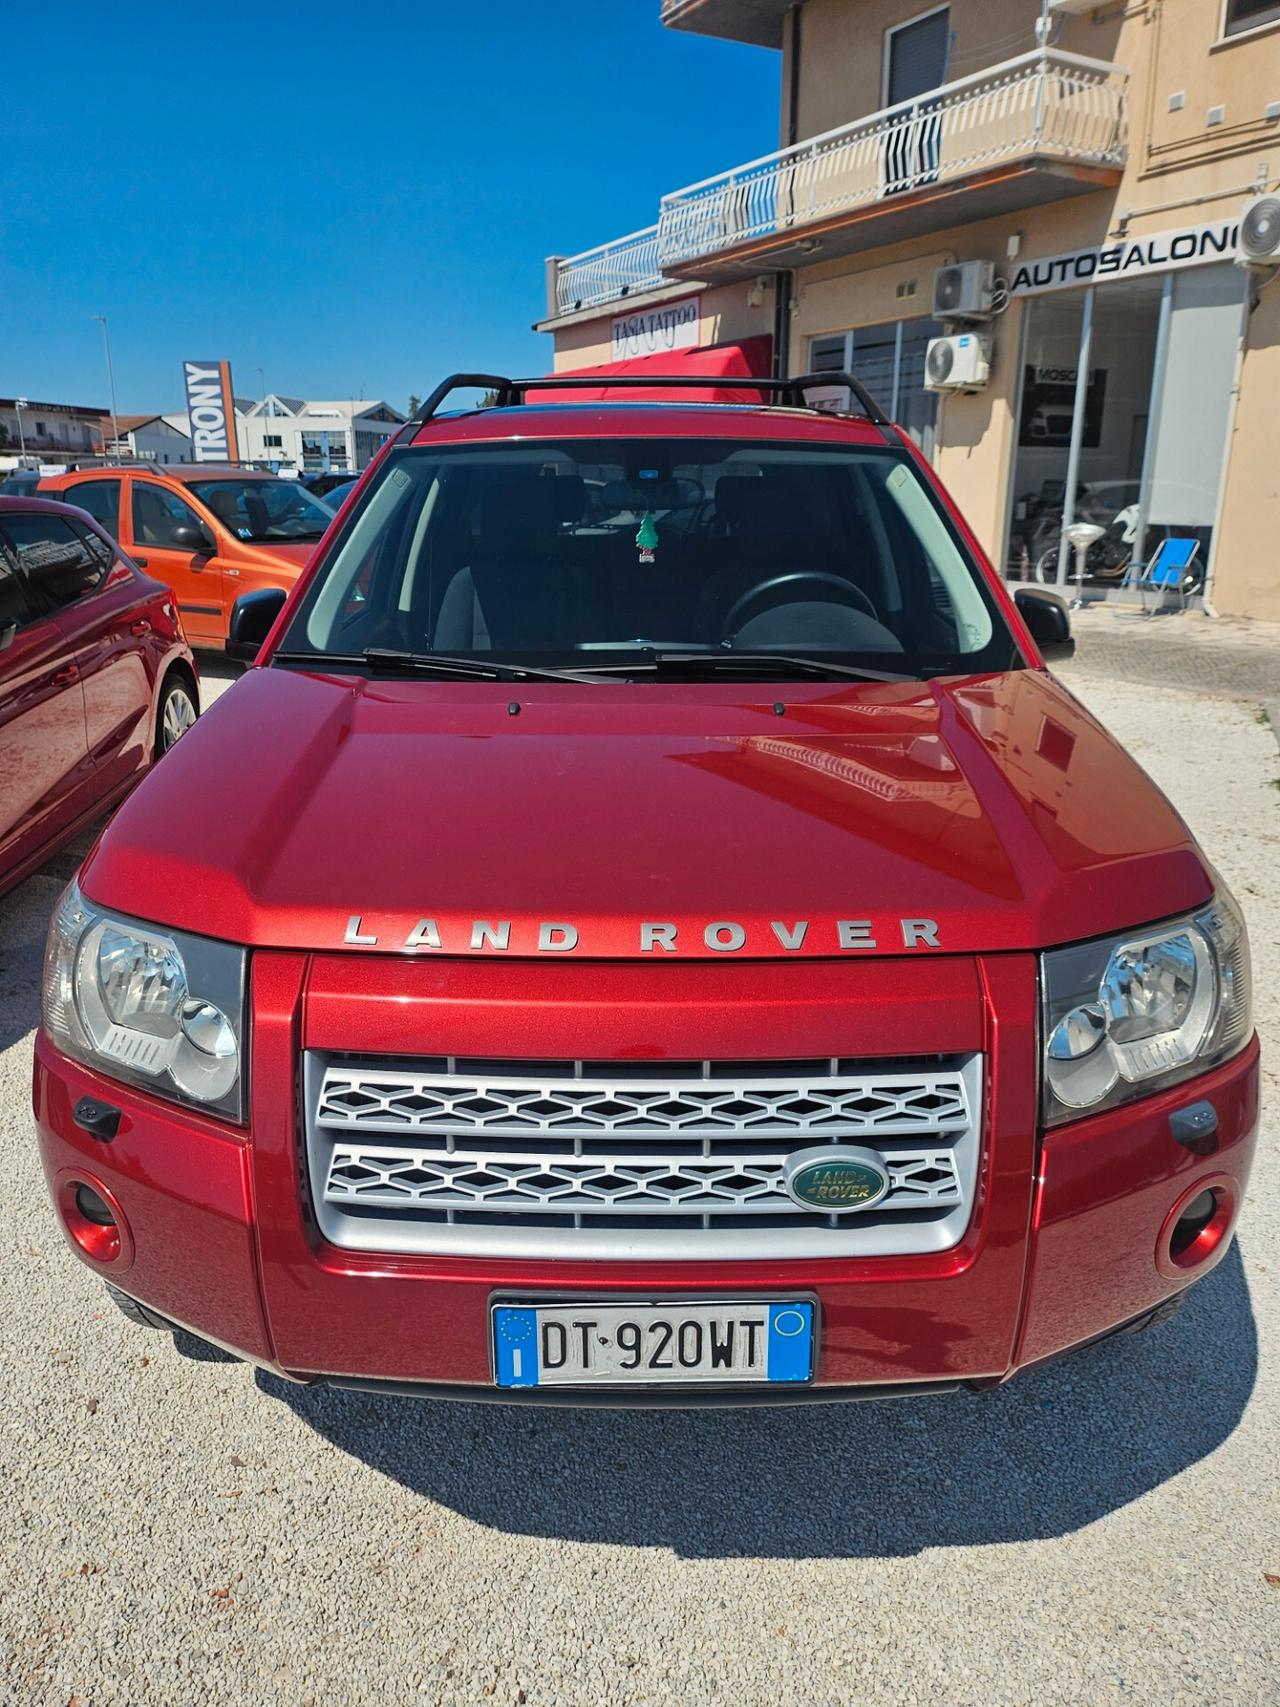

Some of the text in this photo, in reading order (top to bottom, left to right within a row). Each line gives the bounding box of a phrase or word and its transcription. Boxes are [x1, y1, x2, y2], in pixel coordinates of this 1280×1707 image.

[646, 303, 697, 349] TATTOO
[185, 363, 229, 462] TRONY
[344, 915, 941, 953] LAND ROVER
[813, 1170, 858, 1185] LAND
[816, 1184, 871, 1199] ROVER
